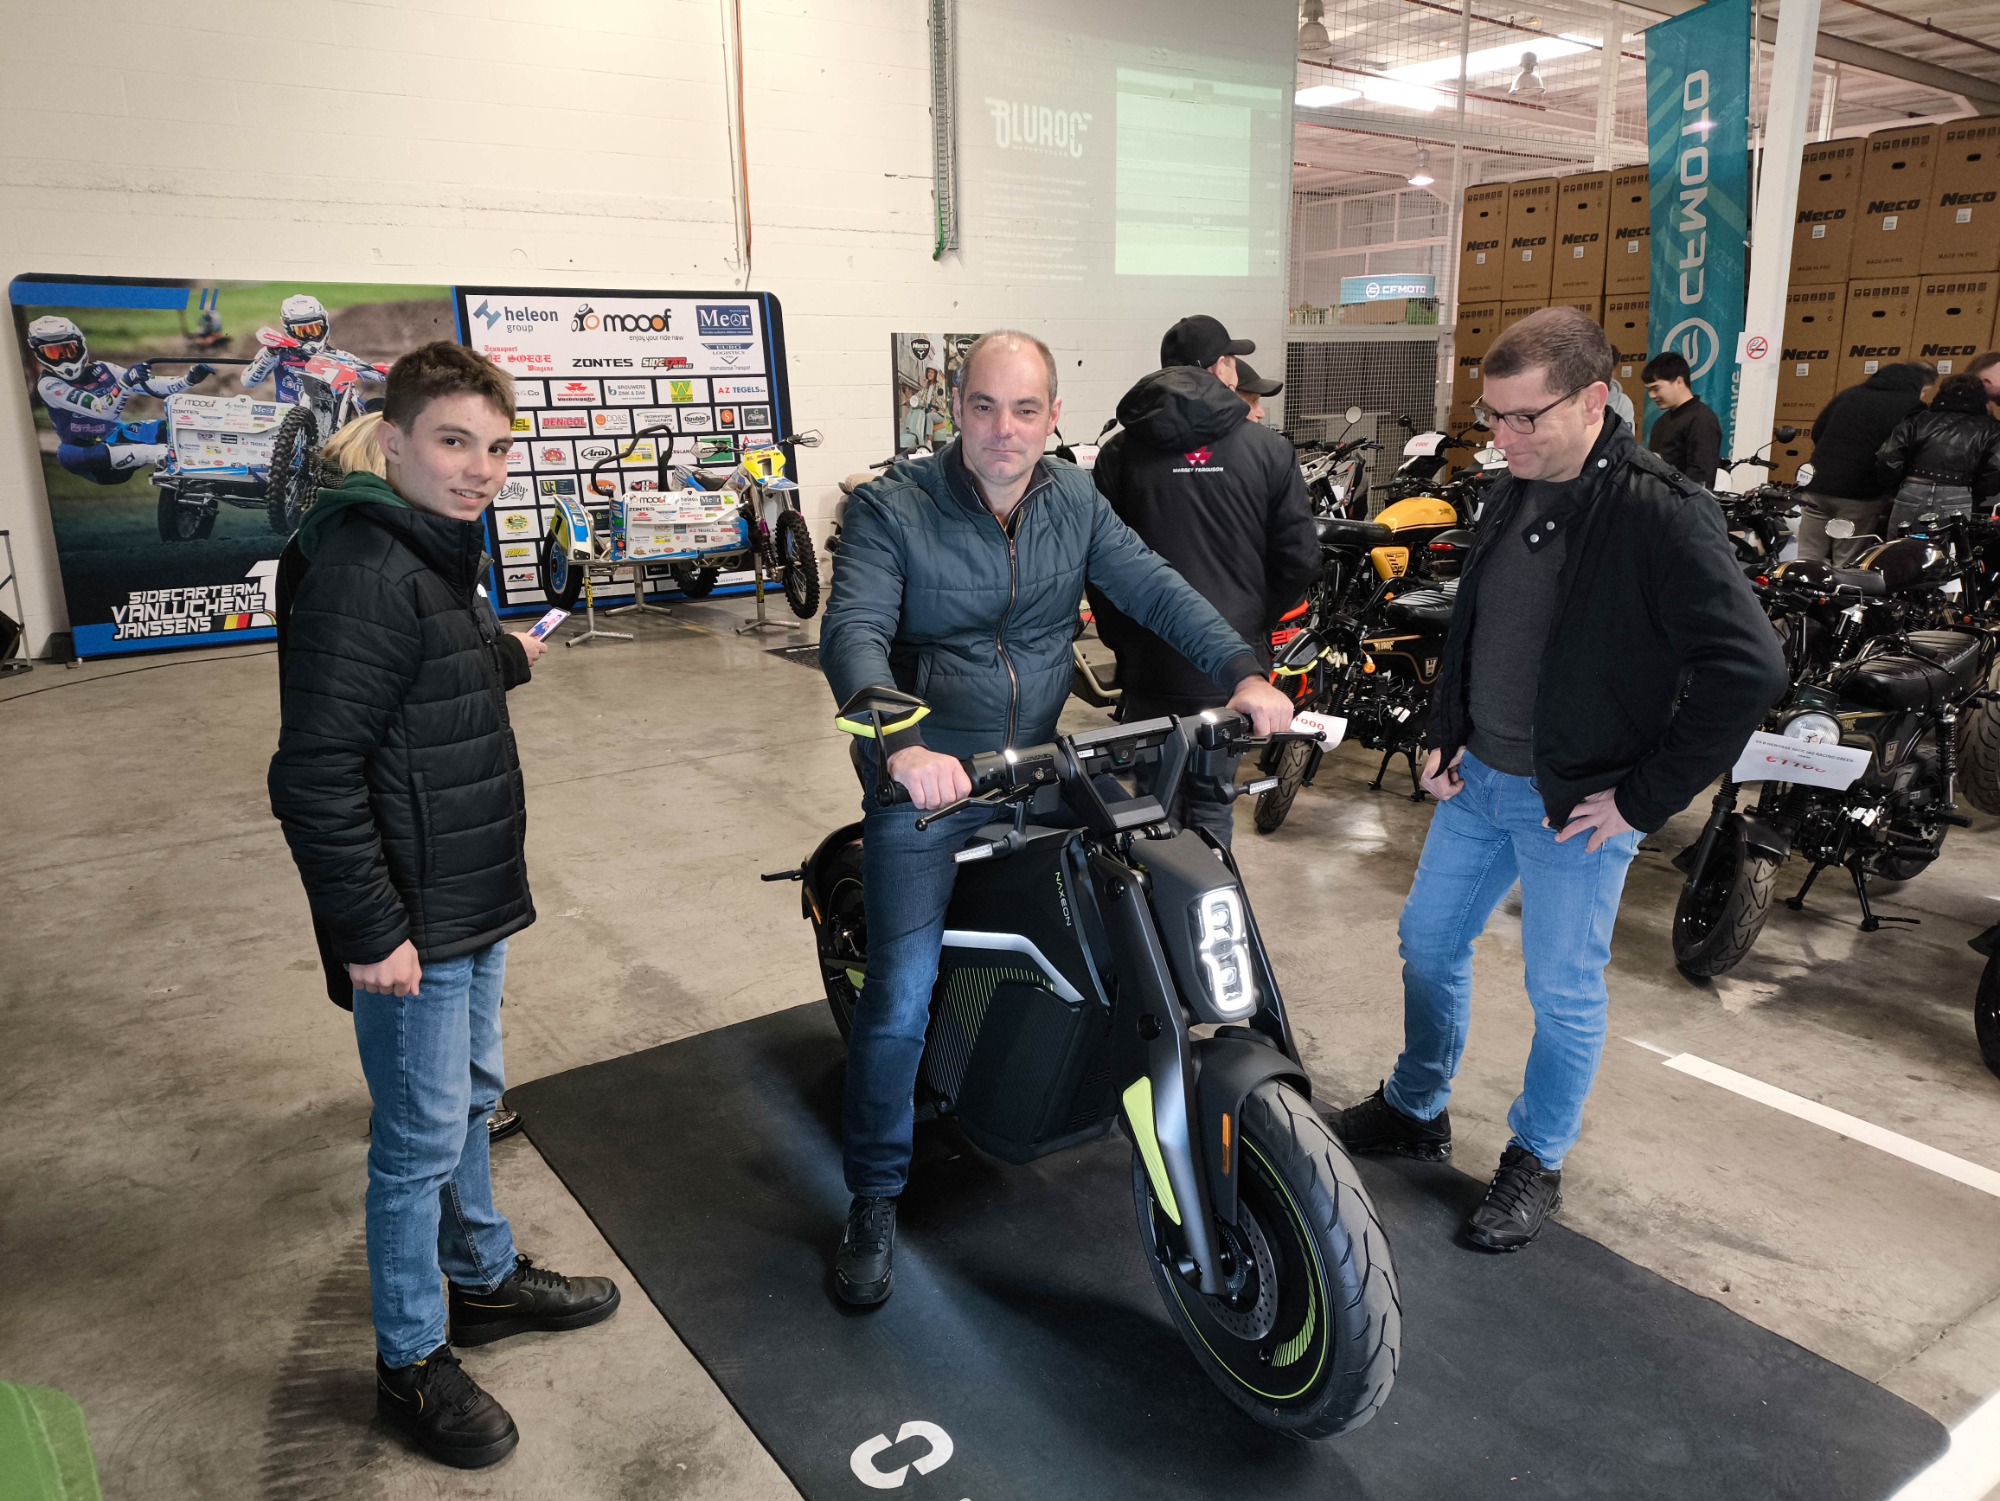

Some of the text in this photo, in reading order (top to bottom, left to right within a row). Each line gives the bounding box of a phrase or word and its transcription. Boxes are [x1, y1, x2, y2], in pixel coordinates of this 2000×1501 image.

[1939, 191, 1997, 207] Neco
[1866, 199, 1921, 214] Neco
[1797, 208, 1847, 223] Neco
[1562, 233, 1599, 245] Neco
[1615, 227, 1650, 239] Nec
[1466, 240, 1499, 251] Neco
[1512, 236, 1547, 249] Neco
[1382, 285, 1426, 294] CFMOTO
[504, 306, 559, 322] heleon
[603, 308, 671, 333] mooof
[507, 324, 533, 334] group
[1781, 348, 1829, 361] Neco
[1849, 344, 1901, 358] Neco
[1920, 343, 1977, 357] Neco
[572, 358, 633, 367] ZONTES
[1459, 356, 1482, 366] Nec
[1619, 352, 1647, 363] eco
[128, 582, 260, 605] SIDECARTEAM
[111, 594, 265, 624] VANLUCHENE
[114, 616, 212, 640] JANSSENS
[1815, 752, 1836, 760] RACING
